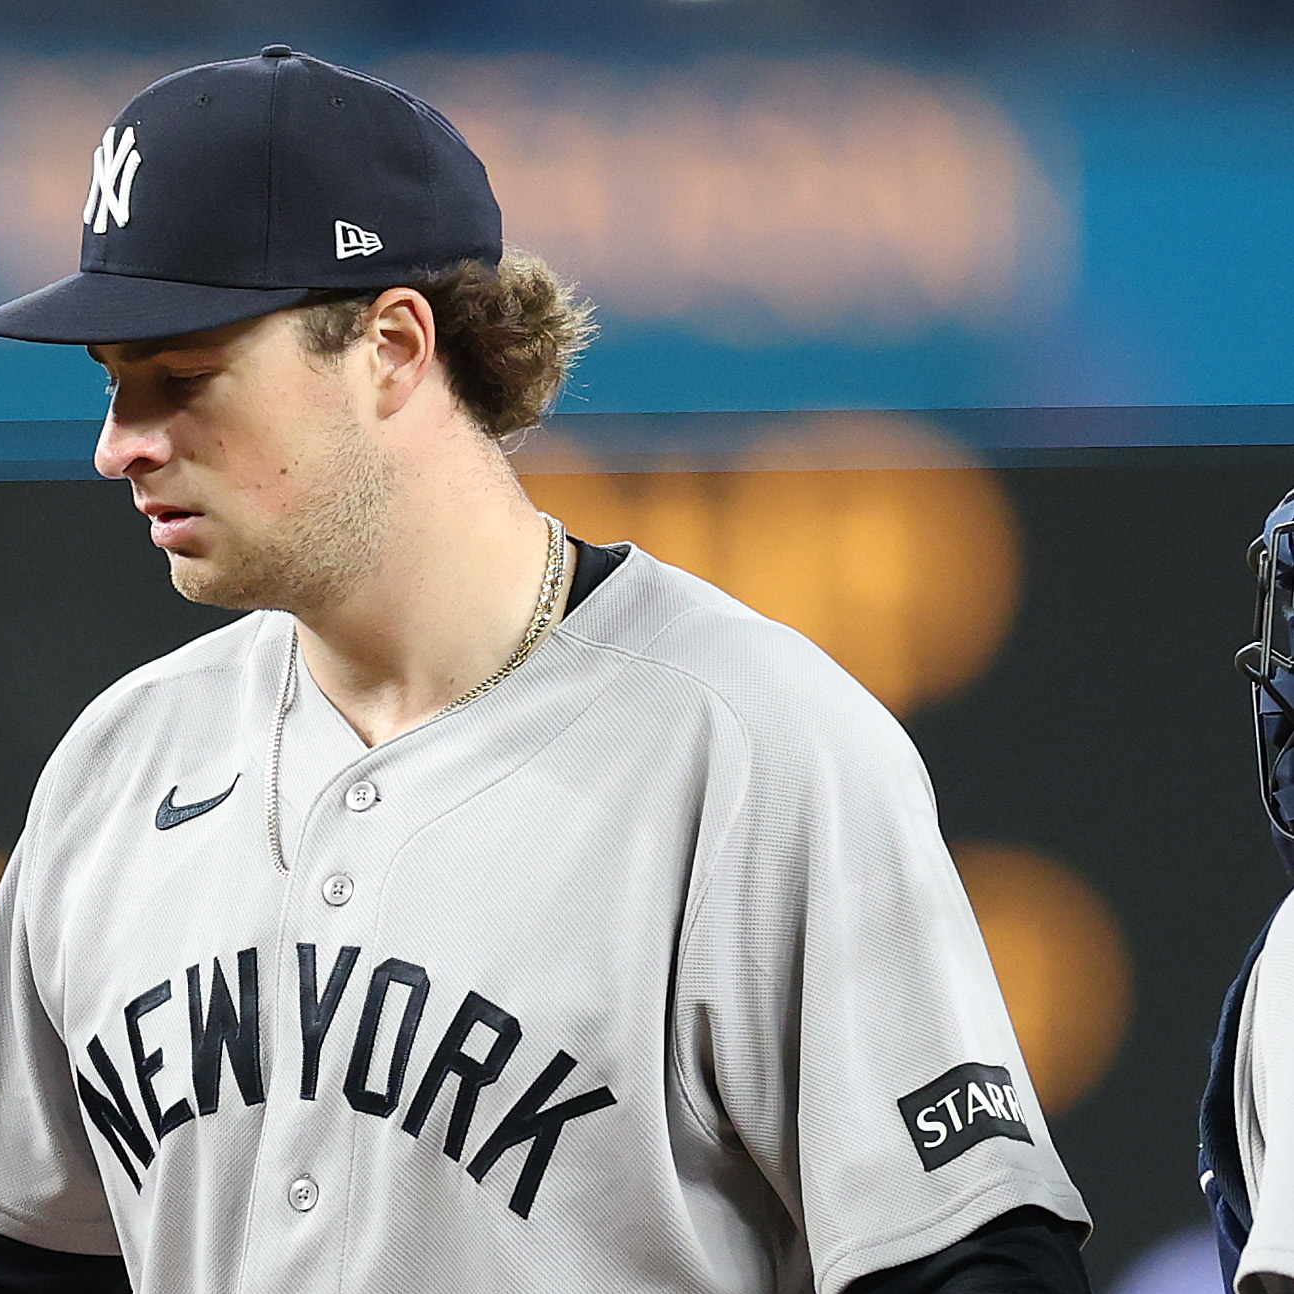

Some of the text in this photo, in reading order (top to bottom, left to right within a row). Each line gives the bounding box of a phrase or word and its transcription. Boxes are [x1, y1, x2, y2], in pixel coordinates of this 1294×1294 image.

[83, 126, 142, 234] NY
[76, 946, 265, 1195] NEW
[296, 942, 618, 1220] YORK
